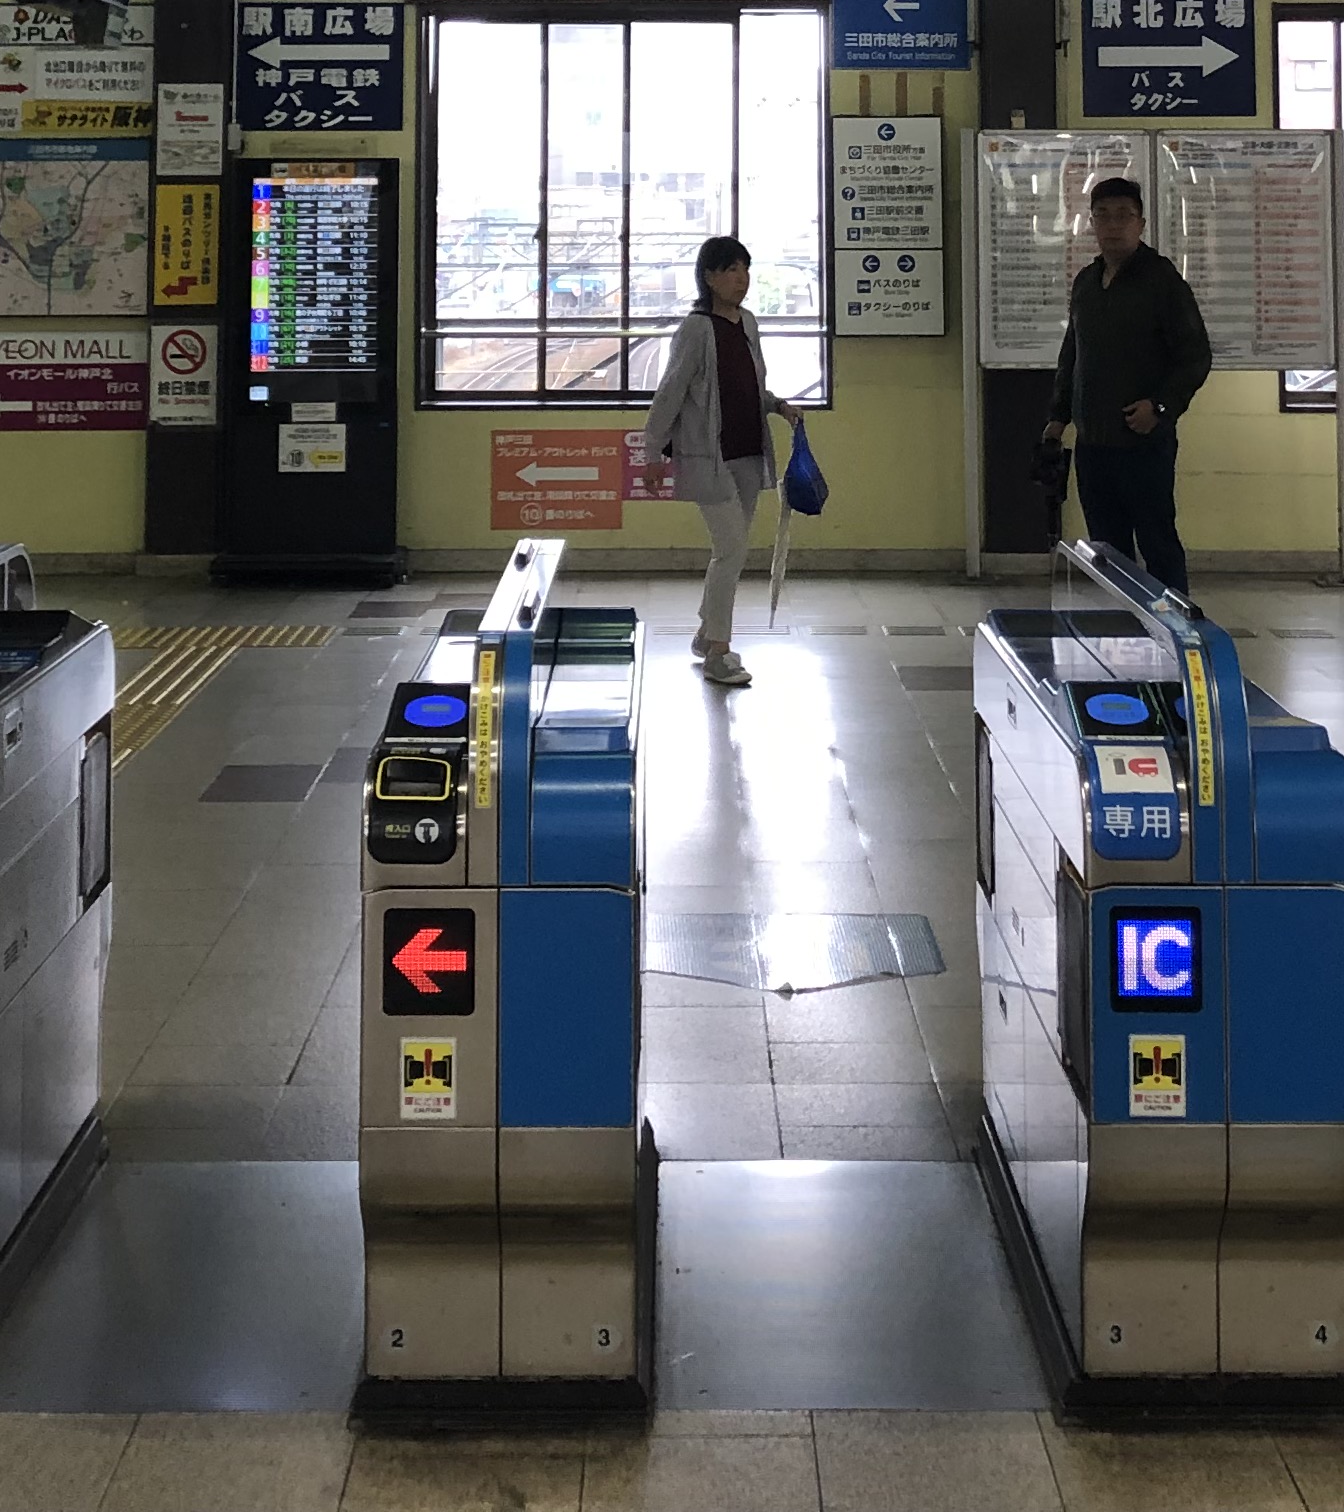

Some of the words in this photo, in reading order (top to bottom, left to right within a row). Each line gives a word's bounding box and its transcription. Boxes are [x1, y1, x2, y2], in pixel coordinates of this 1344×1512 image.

[242, 6, 395, 37] 駅南広場
[844, 32, 958, 48] 三田市総合案内所
[255, 68, 381, 87] 神戸電鉄
[1130, 94, 1199, 111] タクシー
[263, 109, 373, 128] タクシー
[63, 339, 132, 359] MALL
[1102, 804, 1171, 838] 専用
[1122, 925, 1192, 991] IC
[391, 1328, 404, 1348] 2
[598, 1328, 610, 1346] 3
[1110, 1325, 1122, 1344] 3
[1315, 1325, 1327, 1344] 4
